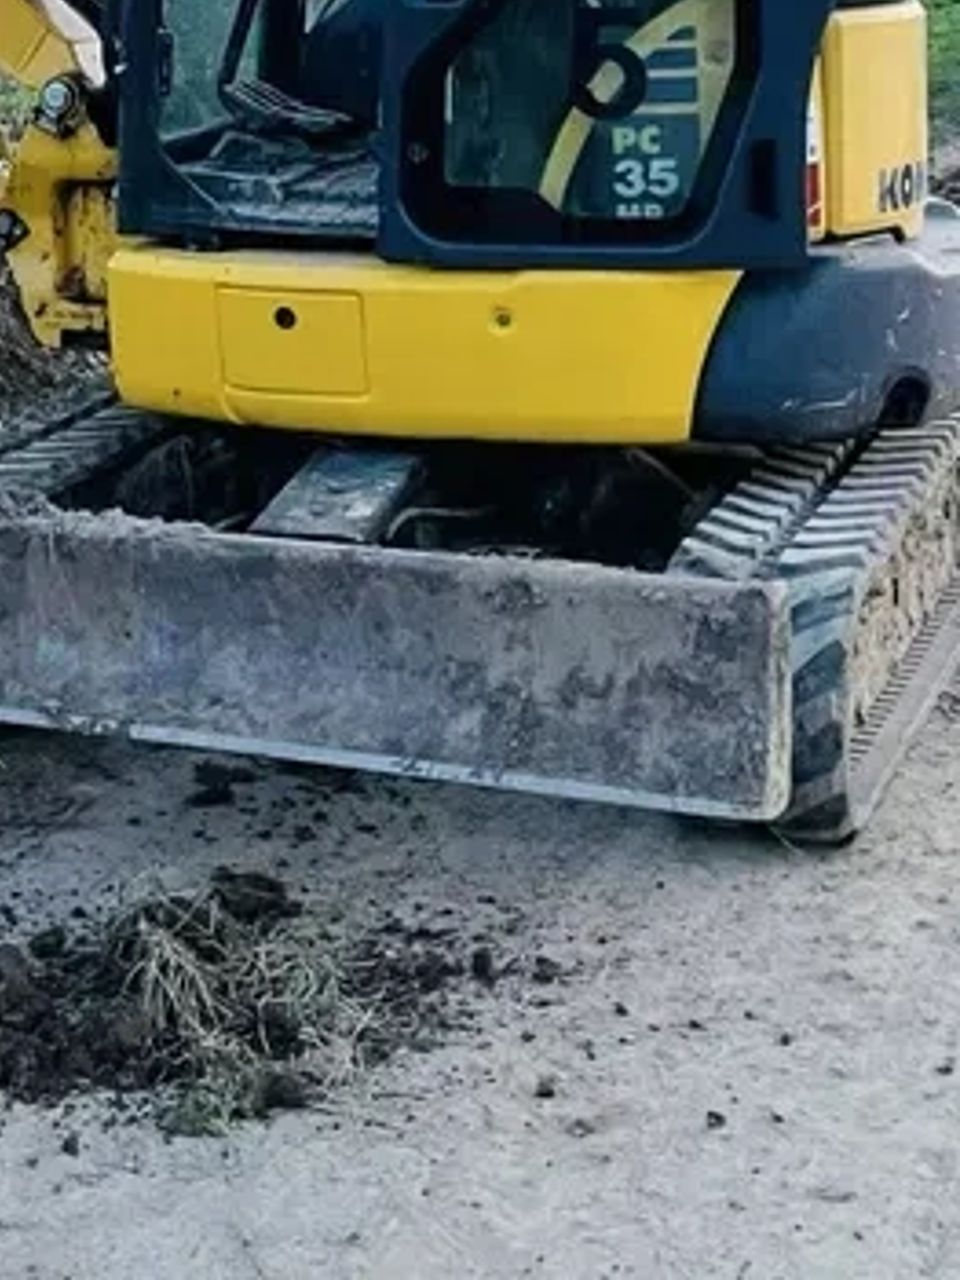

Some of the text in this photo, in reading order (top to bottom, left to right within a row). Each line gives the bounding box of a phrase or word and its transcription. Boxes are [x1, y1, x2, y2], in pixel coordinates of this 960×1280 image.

[612, 126, 661, 155] PC
[613, 158, 679, 198] 35
[878, 162, 923, 214] KO
